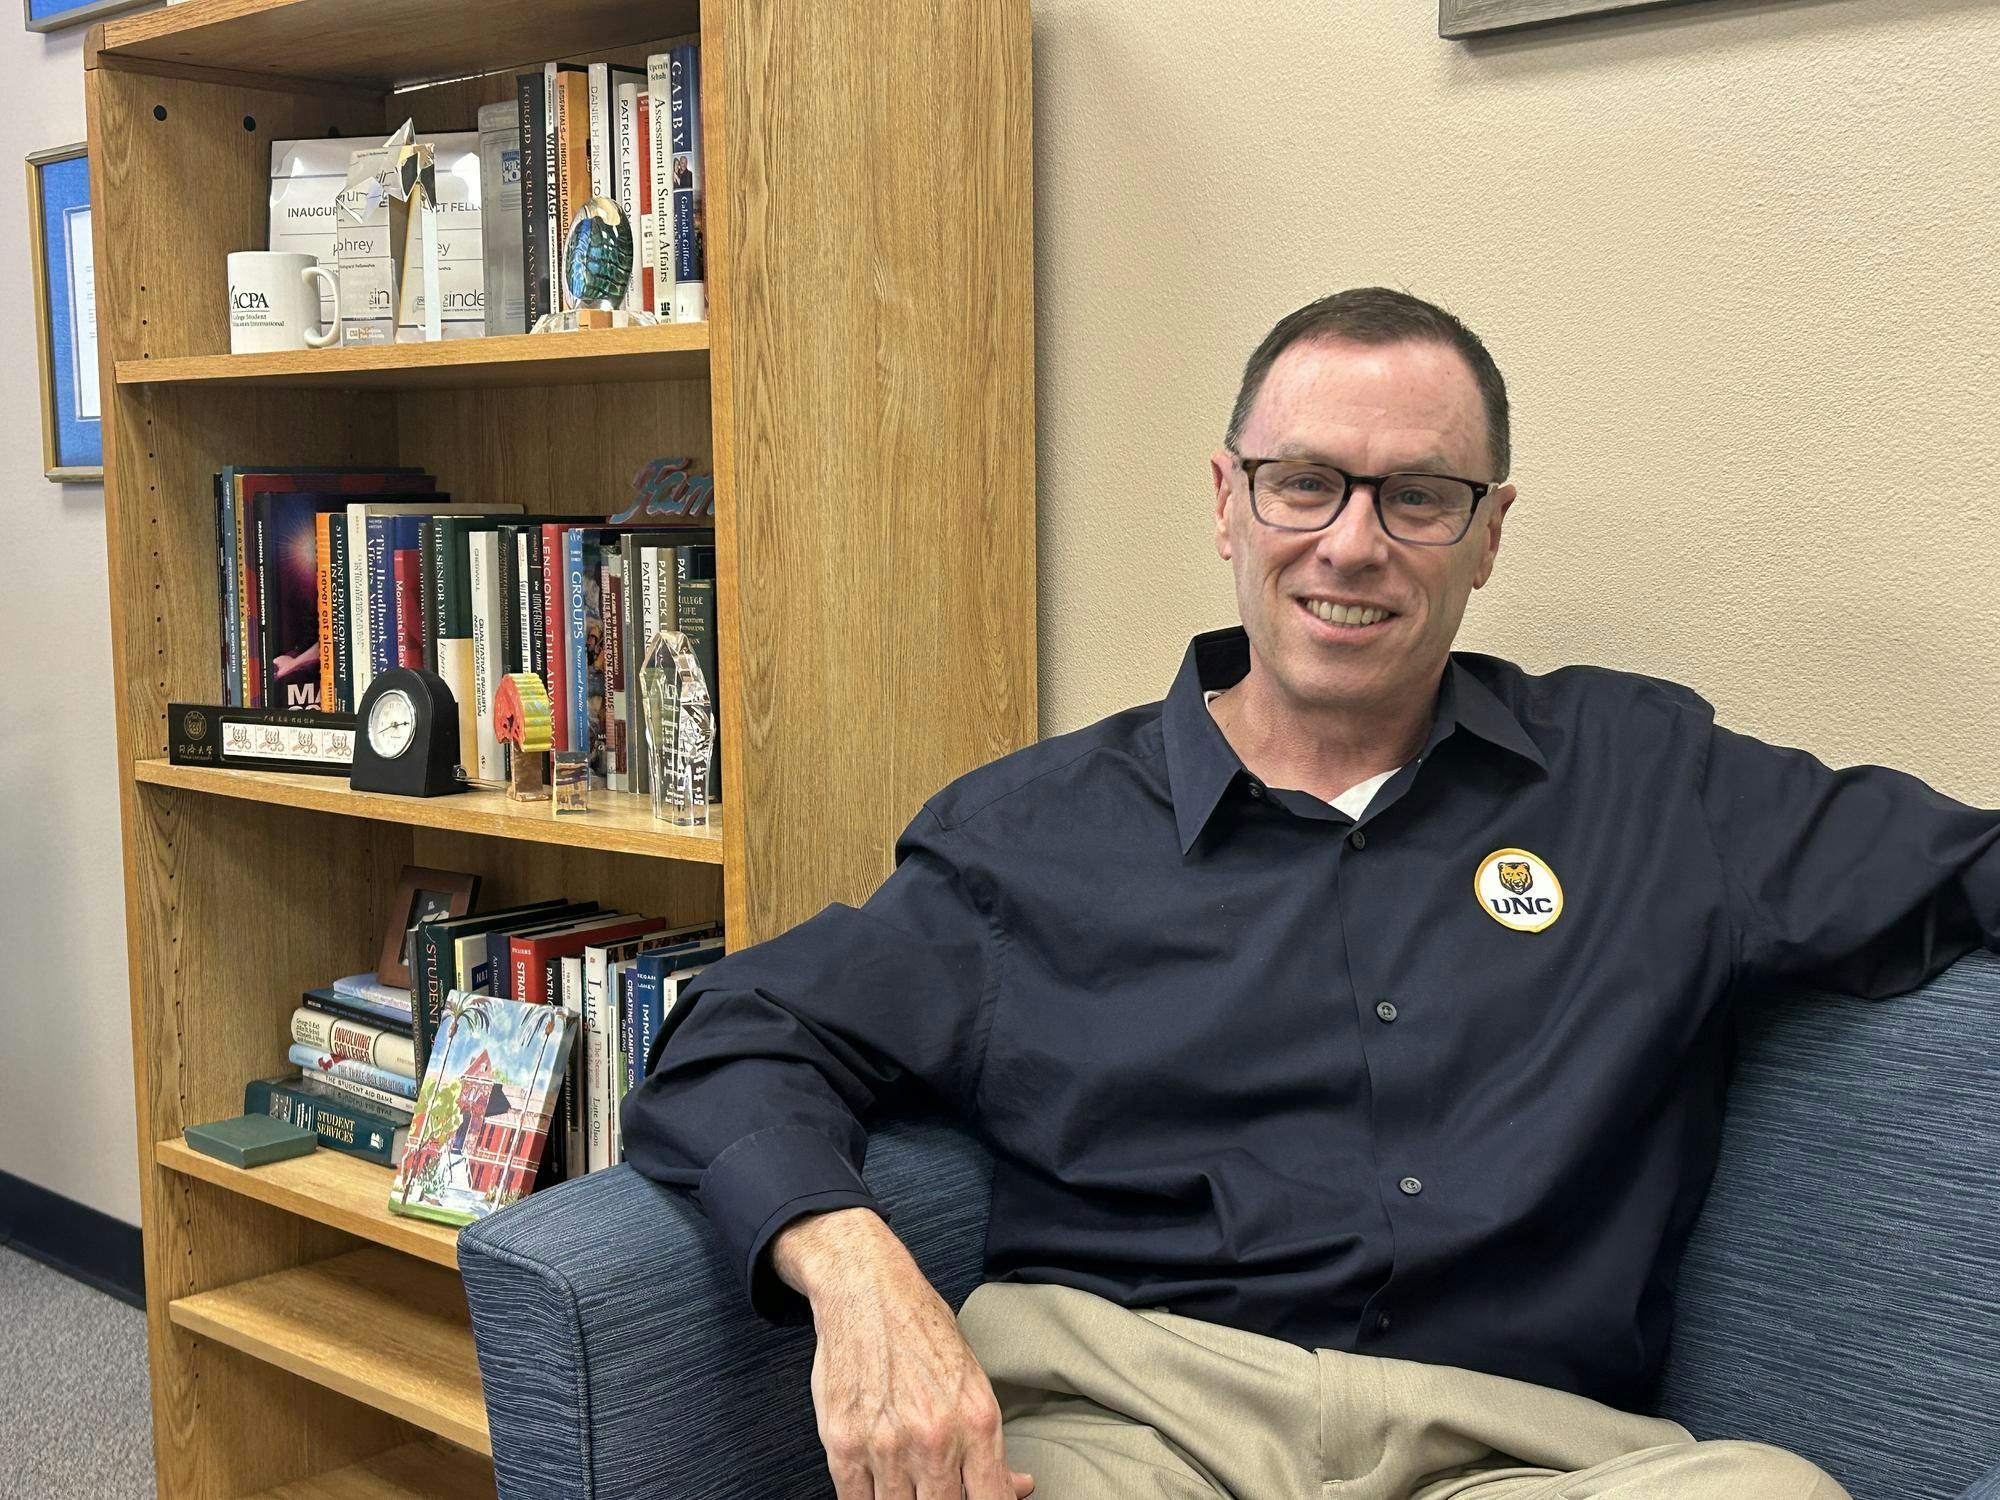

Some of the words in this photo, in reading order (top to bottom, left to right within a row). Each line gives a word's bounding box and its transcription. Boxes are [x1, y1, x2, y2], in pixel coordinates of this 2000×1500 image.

[523, 86, 532, 144] FORGED
[591, 86, 599, 126] DANIEL
[672, 61, 684, 147] GABBY
[621, 99, 630, 157] PATRICK
[655, 98, 666, 168] Assessment
[525, 150, 532, 166] IN
[546, 133, 556, 177] WHITE
[560, 143, 568, 193] ENROLLMENT
[592, 144, 600, 172] PINK
[593, 180, 601, 197] TO
[656, 172, 665, 185] in
[548, 183, 557, 219] RAGE
[657, 187, 669, 235] Student
[681, 195, 690, 238] Gabrielle
[659, 241, 671, 283] Affairs
[682, 239, 692, 276] Giffords
[231, 290, 269, 309] ACPA
[336, 525, 346, 566] STUDENT
[368, 537, 376, 585] Affairs
[376, 534, 385, 563] The
[332, 562, 337, 575] IN
[437, 554, 446, 601] SENIOR
[543, 536, 551, 611] LENCIONI
[642, 561, 651, 615] PATRICK
[658, 560, 668, 617] PATRICK
[338, 568, 347, 681] DEVELOPMENT
[377, 569, 388, 643] Handbook
[396, 580, 404, 630] Moments
[438, 604, 447, 636] YEAR
[533, 593, 543, 638] UNIVERSITY
[571, 571, 583, 640] GROUPS
[322, 634, 332, 670] alone
[380, 648, 388, 664] of
[1491, 897, 1553, 915] UNC
[426, 943, 440, 1026] STUDENT
[588, 979, 601, 1035] Lute!
[334, 1042, 371, 1065] COLLEGES
[335, 1026, 371, 1051] INVOLVING
[325, 1075, 337, 1085] THE
[338, 1078, 364, 1095] STUDENT
[317, 1110, 355, 1131] STUDENT
[593, 1097, 601, 1119] Lute
[316, 1123, 354, 1144] SERVICES
